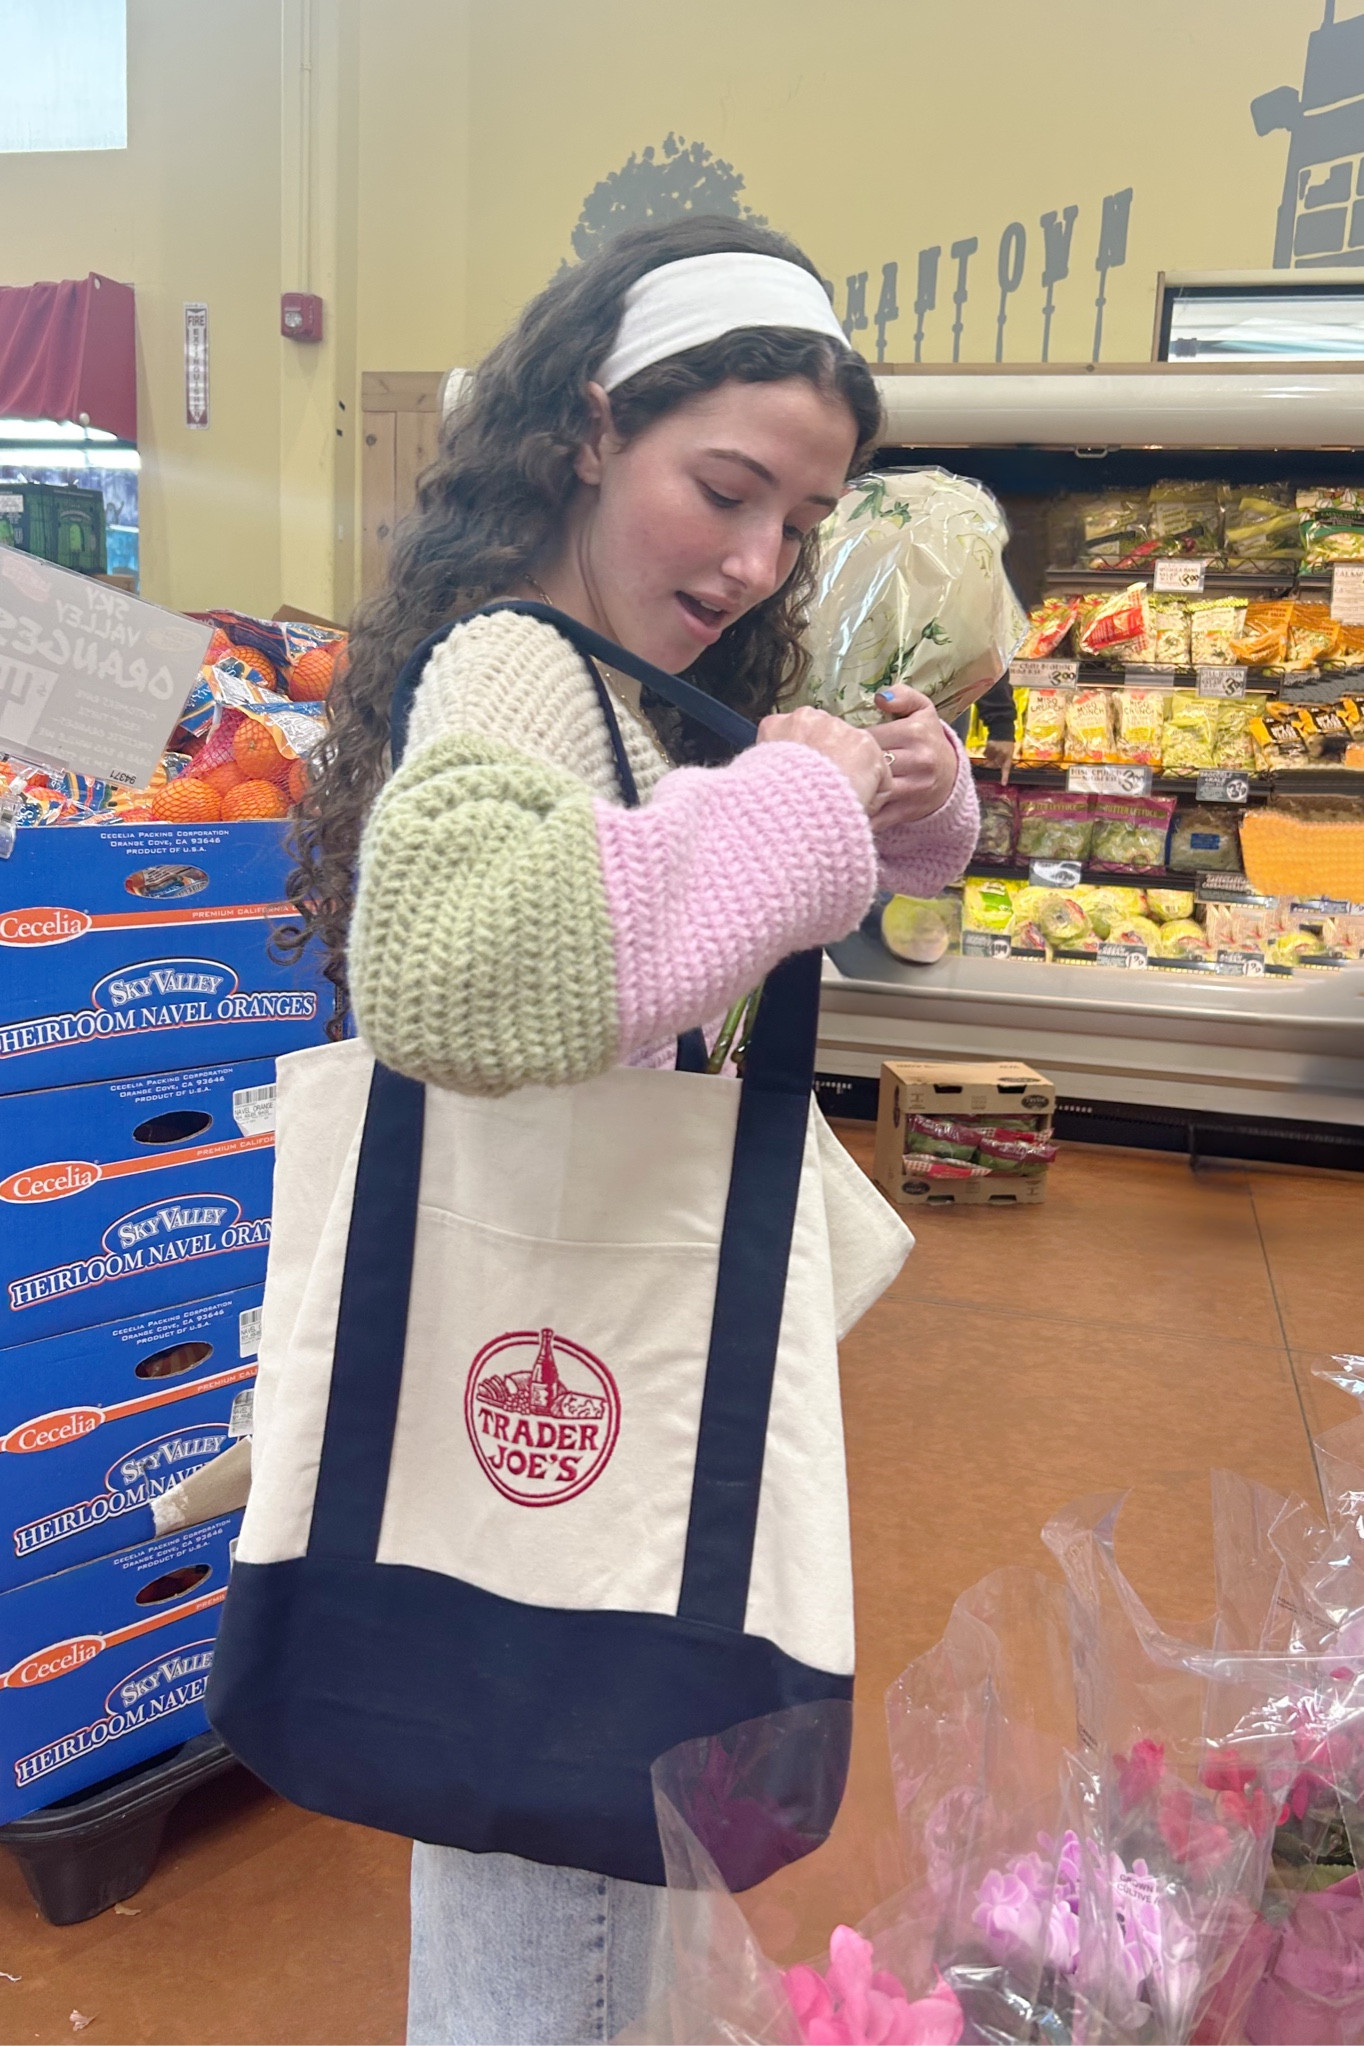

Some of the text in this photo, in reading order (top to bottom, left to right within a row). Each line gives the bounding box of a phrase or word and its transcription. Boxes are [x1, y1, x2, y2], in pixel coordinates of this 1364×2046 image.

[187, 315, 205, 326] FIRE
[109, 769, 137, 785] 94371
[147, 839, 172, 847] COVE,
[190, 837, 221, 845] 93646
[176, 829, 230, 837] CORPORATION
[126, 847, 167, 855] PRODUCT
[169, 846, 181, 854] OF
[0, 911, 83, 939] Cecelia
[192, 909, 234, 918] PREMIUM
[109, 967, 224, 1007] SKY VALLEY
[0, 996, 314, 1053] HEIRLOOM NAVEL ORANGES
[110, 1067, 233, 1092] CECELIA PACKING CORPORATION
[119, 1088, 152, 1098] ORANGE
[155, 1085, 179, 1093] COVE,
[196, 1076, 225, 1086] 93646
[135, 1093, 173, 1103] PRODUCT
[189, 1087, 212, 1095] U.S.A.
[196, 1144, 237, 1157] PREMIUM
[13, 1165, 92, 1198] Cecelia
[118, 1206, 228, 1249] SKY VALLEY
[13, 1249, 144, 1306] HEIRLOOM
[148, 1234, 216, 1264] NAVEL
[112, 1301, 233, 1337] CECELIA PACKING CORPORATION
[121, 1330, 153, 1342] ORANGE
[156, 1323, 180, 1332] COVE,
[196, 1309, 225, 1322] 93646
[136, 1322, 211, 1345] PRODUCT OF U.S.A.
[197, 1375, 237, 1392] PREMIUM
[19, 1414, 96, 1450] Cecelia
[478, 1407, 599, 1451] TRADER
[159, 1435, 228, 1465] VALLEY
[488, 1444, 583, 1482] JOE'S
[18, 1485, 145, 1550] HEIRLOOM
[114, 1519, 231, 1565] CECELIA PACKING CORPORATION
[123, 1555, 154, 1569] ORANGE
[157, 1546, 179, 1557] COVE,
[195, 1528, 223, 1543] 93646
[137, 1542, 211, 1571] PRODUCT OF U.S.A.
[21, 1644, 97, 1683] Cecelia
[121, 1671, 160, 1707] SKY
[19, 1704, 145, 1781] HEIRLOOM
[1120, 1874, 1154, 1893] GROWN
